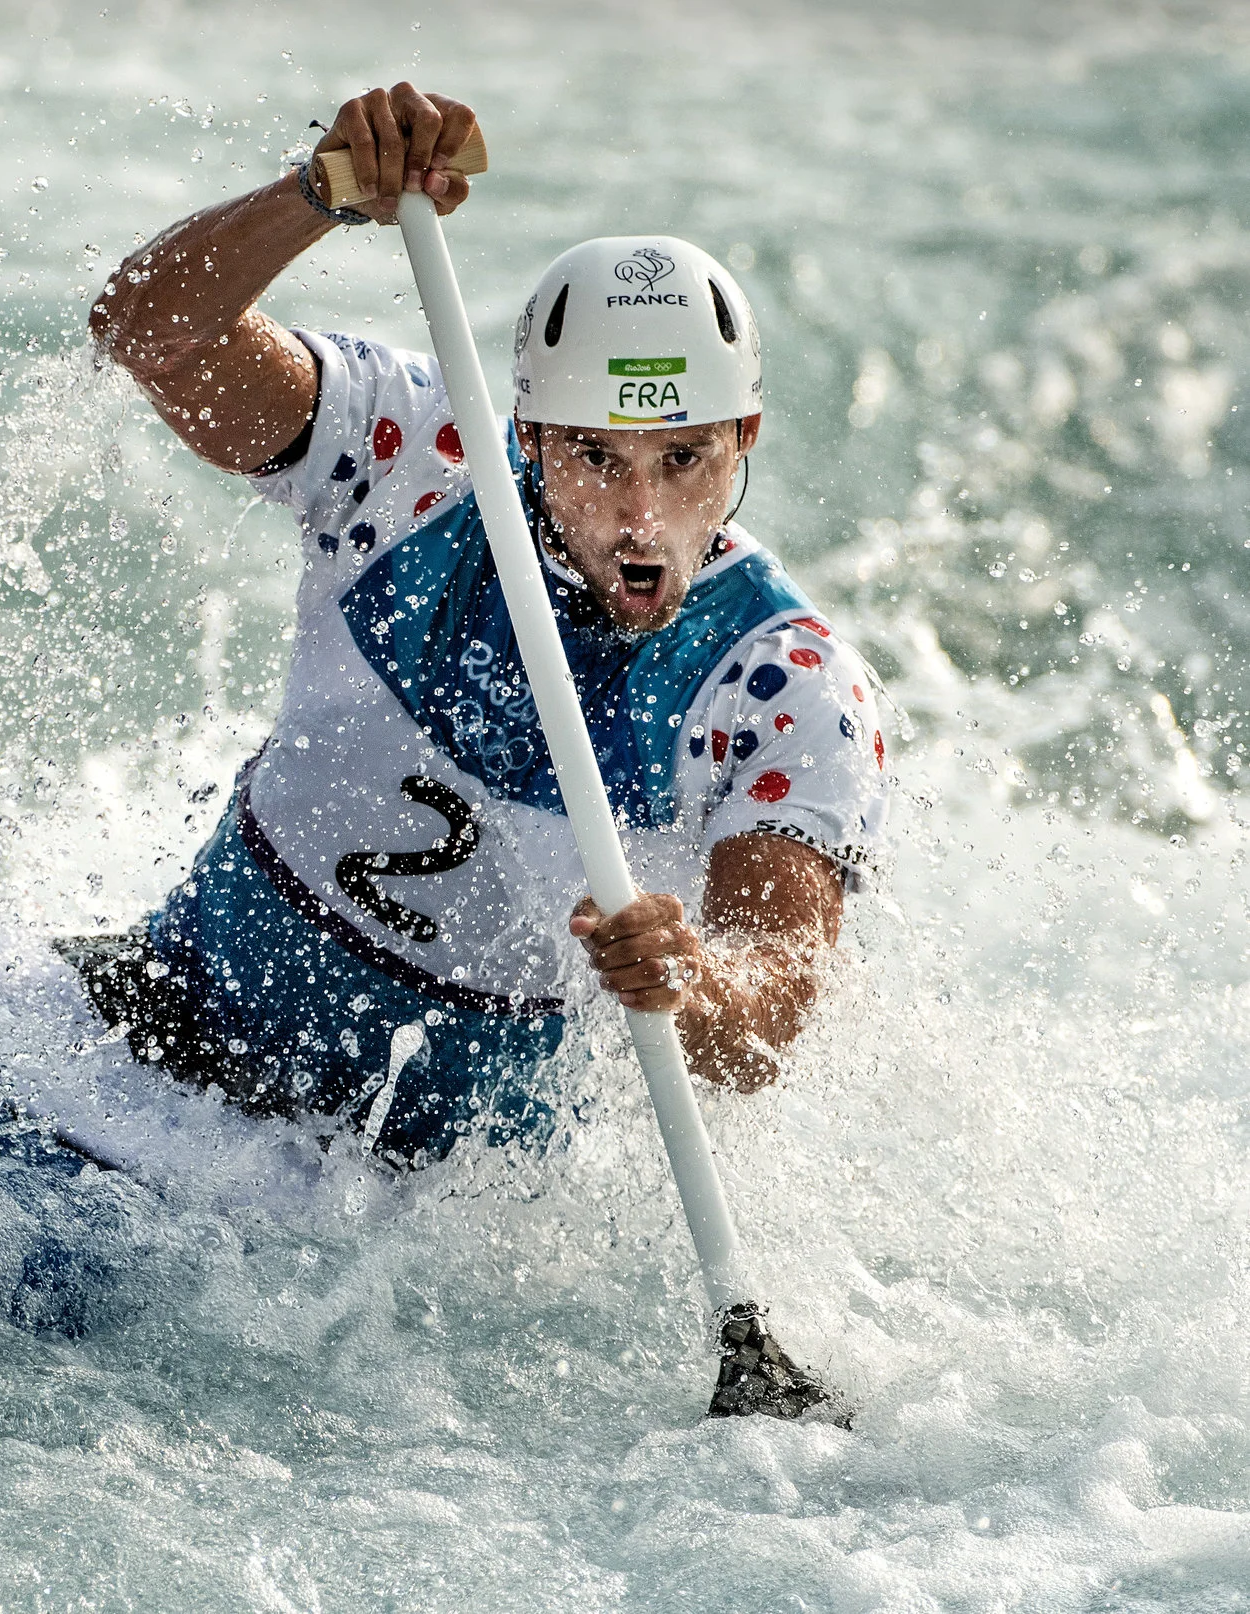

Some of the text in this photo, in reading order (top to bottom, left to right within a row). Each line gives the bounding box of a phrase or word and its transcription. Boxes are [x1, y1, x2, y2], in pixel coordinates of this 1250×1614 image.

[607, 294, 688, 308] FRANCE
[619, 381, 680, 408] FRA
[335, 775, 480, 943] 2
